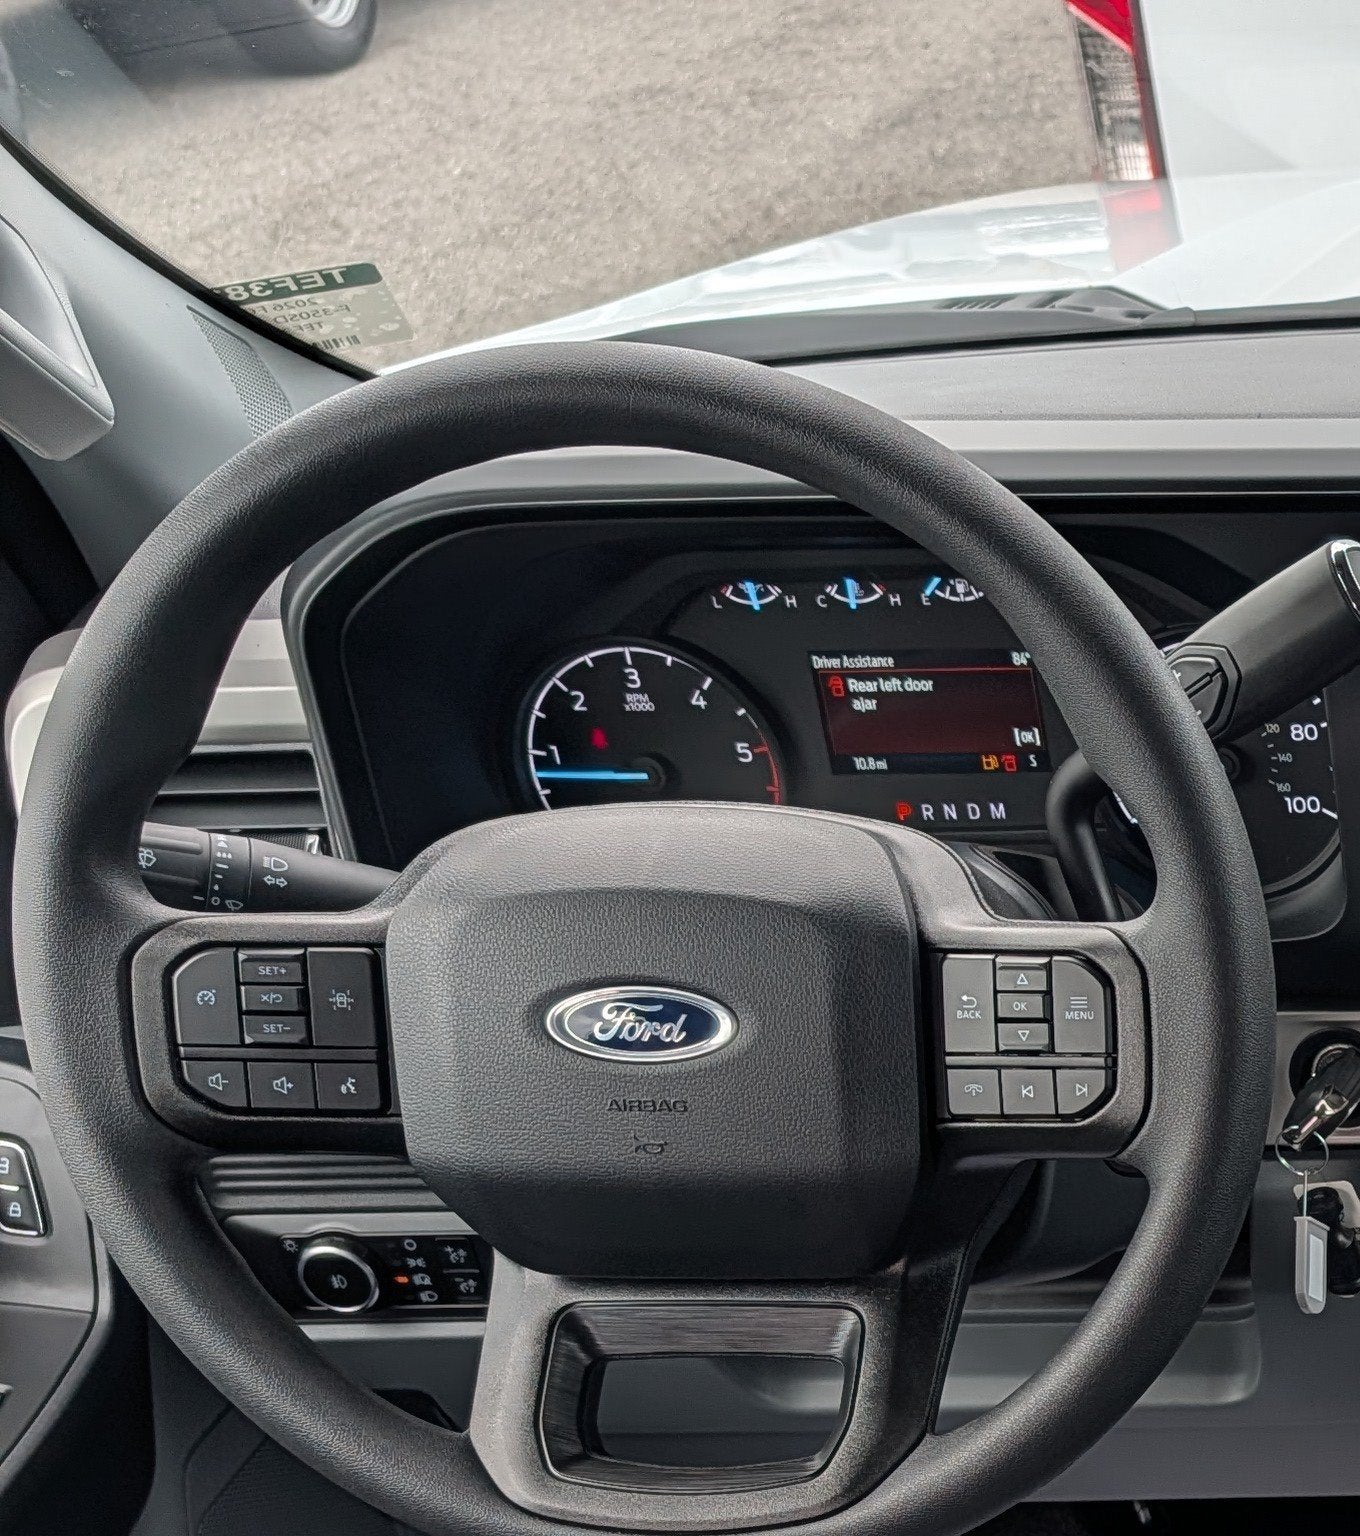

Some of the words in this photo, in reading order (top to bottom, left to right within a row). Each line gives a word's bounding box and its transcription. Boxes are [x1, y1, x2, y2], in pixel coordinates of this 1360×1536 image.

[711, 595, 722, 609] L
[784, 594, 797, 608] H
[816, 595, 828, 608] C
[889, 594, 901, 607] H
[921, 594, 931, 606] E
[811, 655, 843, 669] Driver
[844, 655, 895, 668] Assistance
[624, 668, 641, 689] 3
[848, 678, 878, 693] Rear
[880, 677, 903, 692] left
[904, 677, 934, 692] door
[571, 692, 588, 712] 2
[625, 693, 650, 702] RPM
[690, 690, 708, 710] 4
[852, 696, 878, 713] ajar
[1290, 724, 1318, 741] 80
[549, 745, 561, 765] 1
[735, 743, 753, 763] 5
[1277, 752, 1293, 763] 140
[1028, 755, 1037, 767] S
[896, 802, 913, 820] P
[921, 803, 935, 820] R
[943, 803, 958, 820] N
[966, 803, 981, 820] D
[990, 802, 1006, 819] M
[1284, 796, 1320, 814] 100
[1013, 1001, 1028, 1011] OK
[956, 1010, 982, 1020] BACK
[1065, 1010, 1095, 1020] MENU
[593, 1002, 688, 1043] Ford
[607, 1099, 688, 1113] AIRBAG
